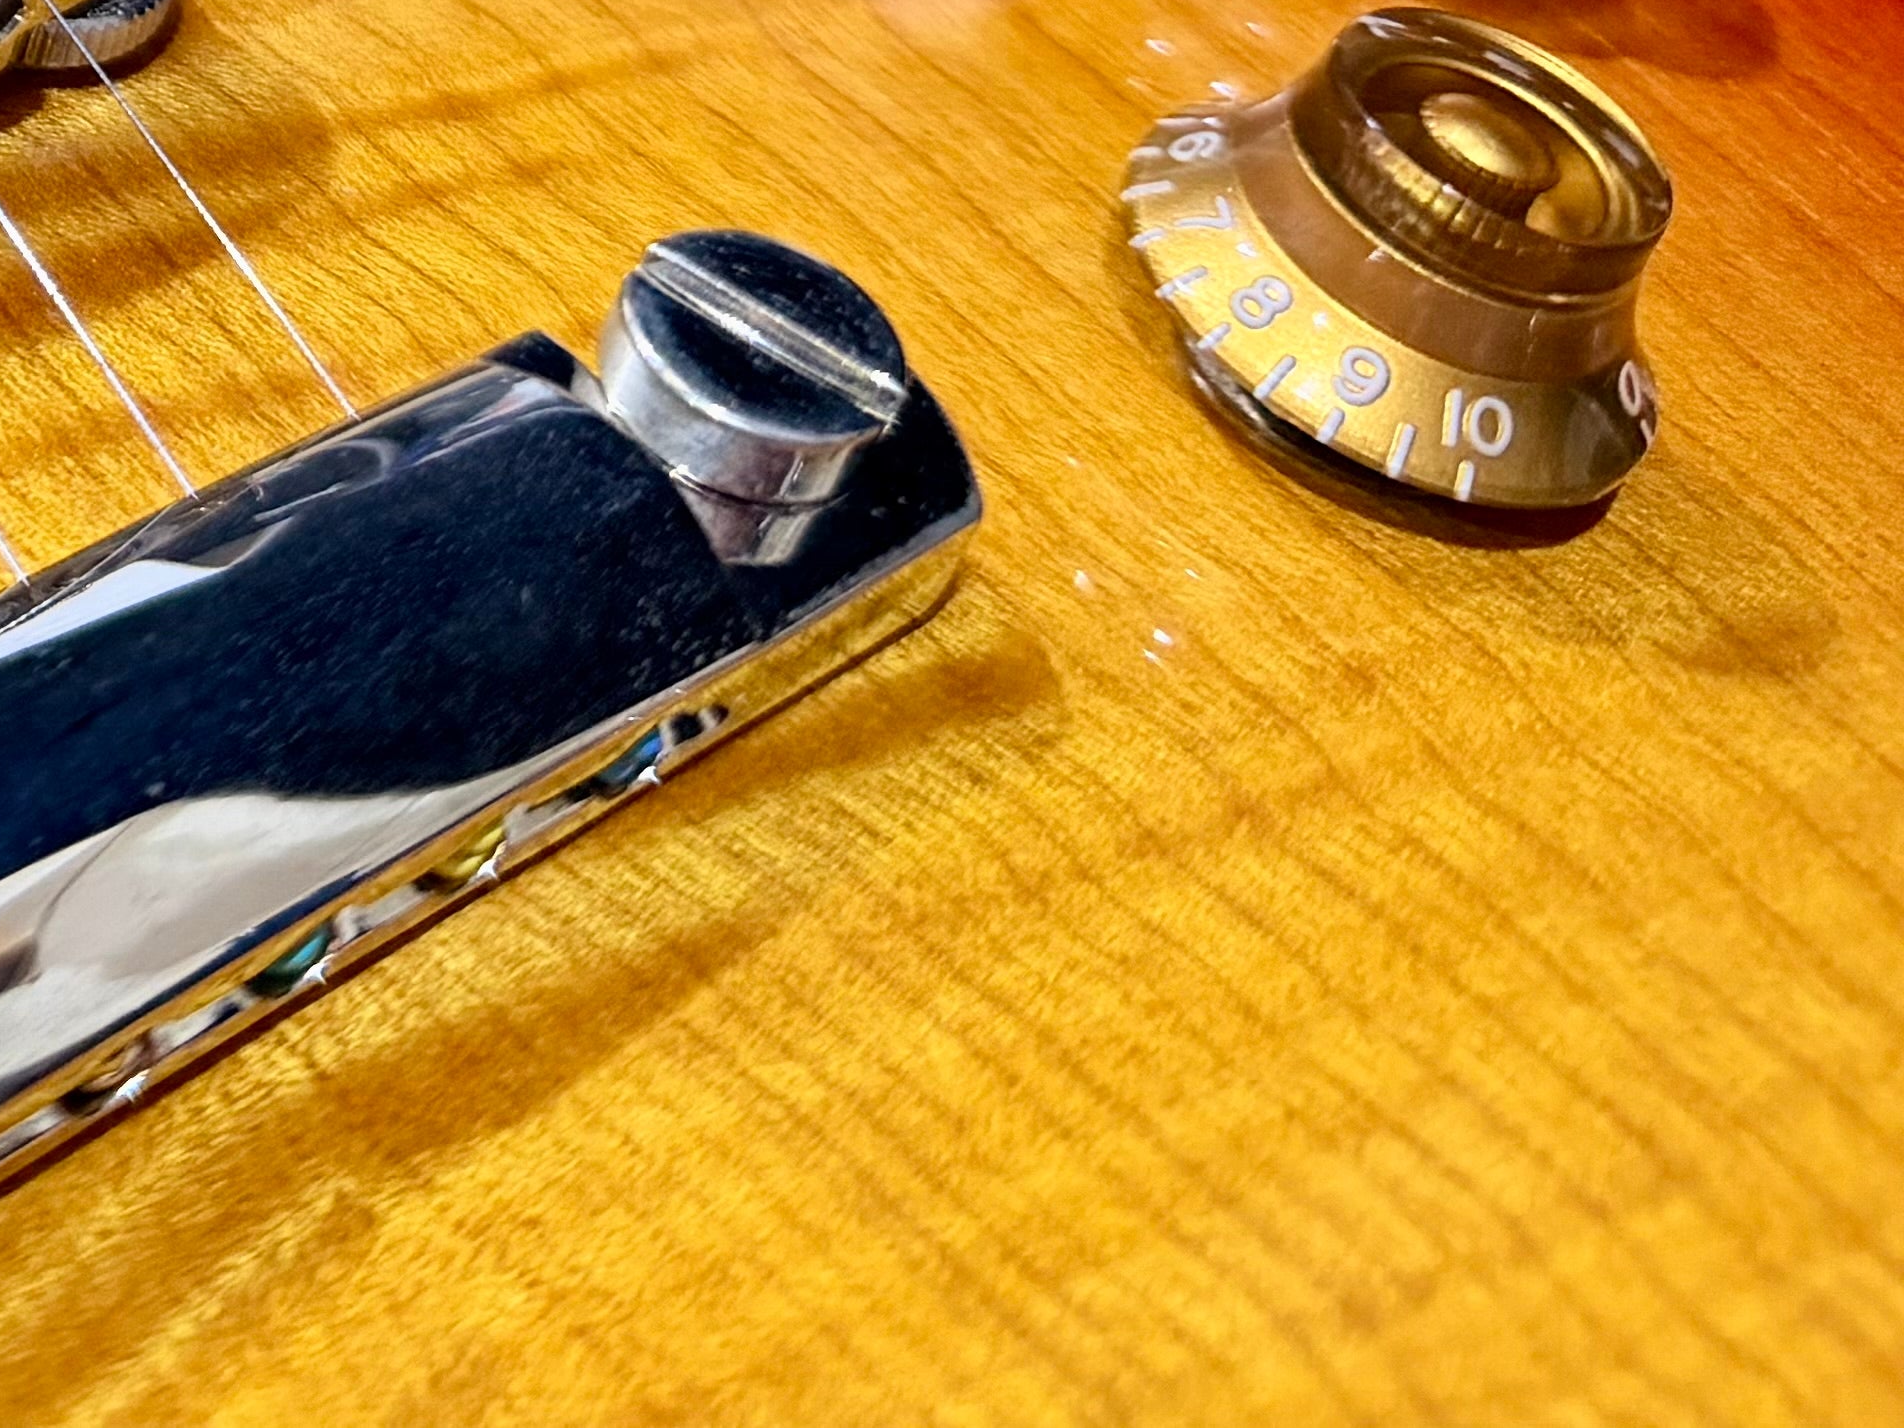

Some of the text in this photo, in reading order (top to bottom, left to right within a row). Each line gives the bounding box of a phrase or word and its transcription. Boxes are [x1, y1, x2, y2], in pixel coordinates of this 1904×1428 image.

[1167, 130, 1642, 458] 6 7 8 9 10 0
